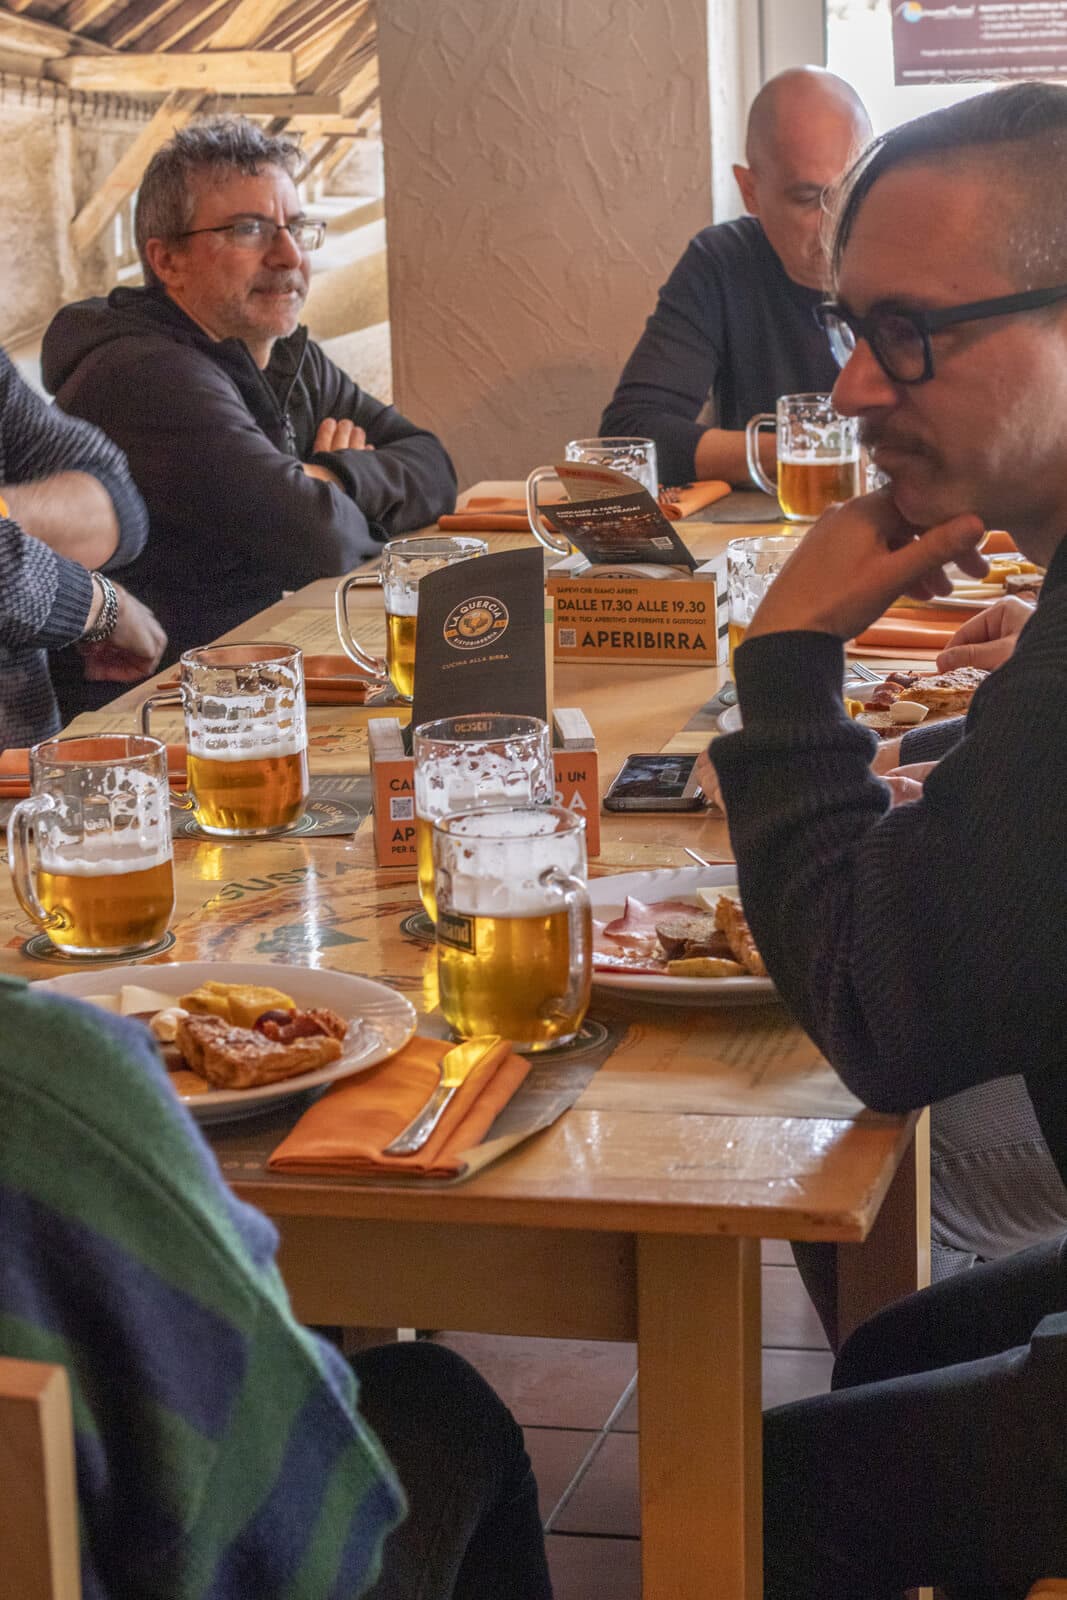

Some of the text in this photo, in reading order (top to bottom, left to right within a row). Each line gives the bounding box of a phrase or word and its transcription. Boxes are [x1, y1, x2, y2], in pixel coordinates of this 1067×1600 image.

[448, 600, 502, 628] LA QUERCIA
[557, 599, 706, 613] DALLE 17.30 ALLE 19.30
[582, 630, 707, 650] APERIBIRRA
[568, 771, 586, 783] UN
